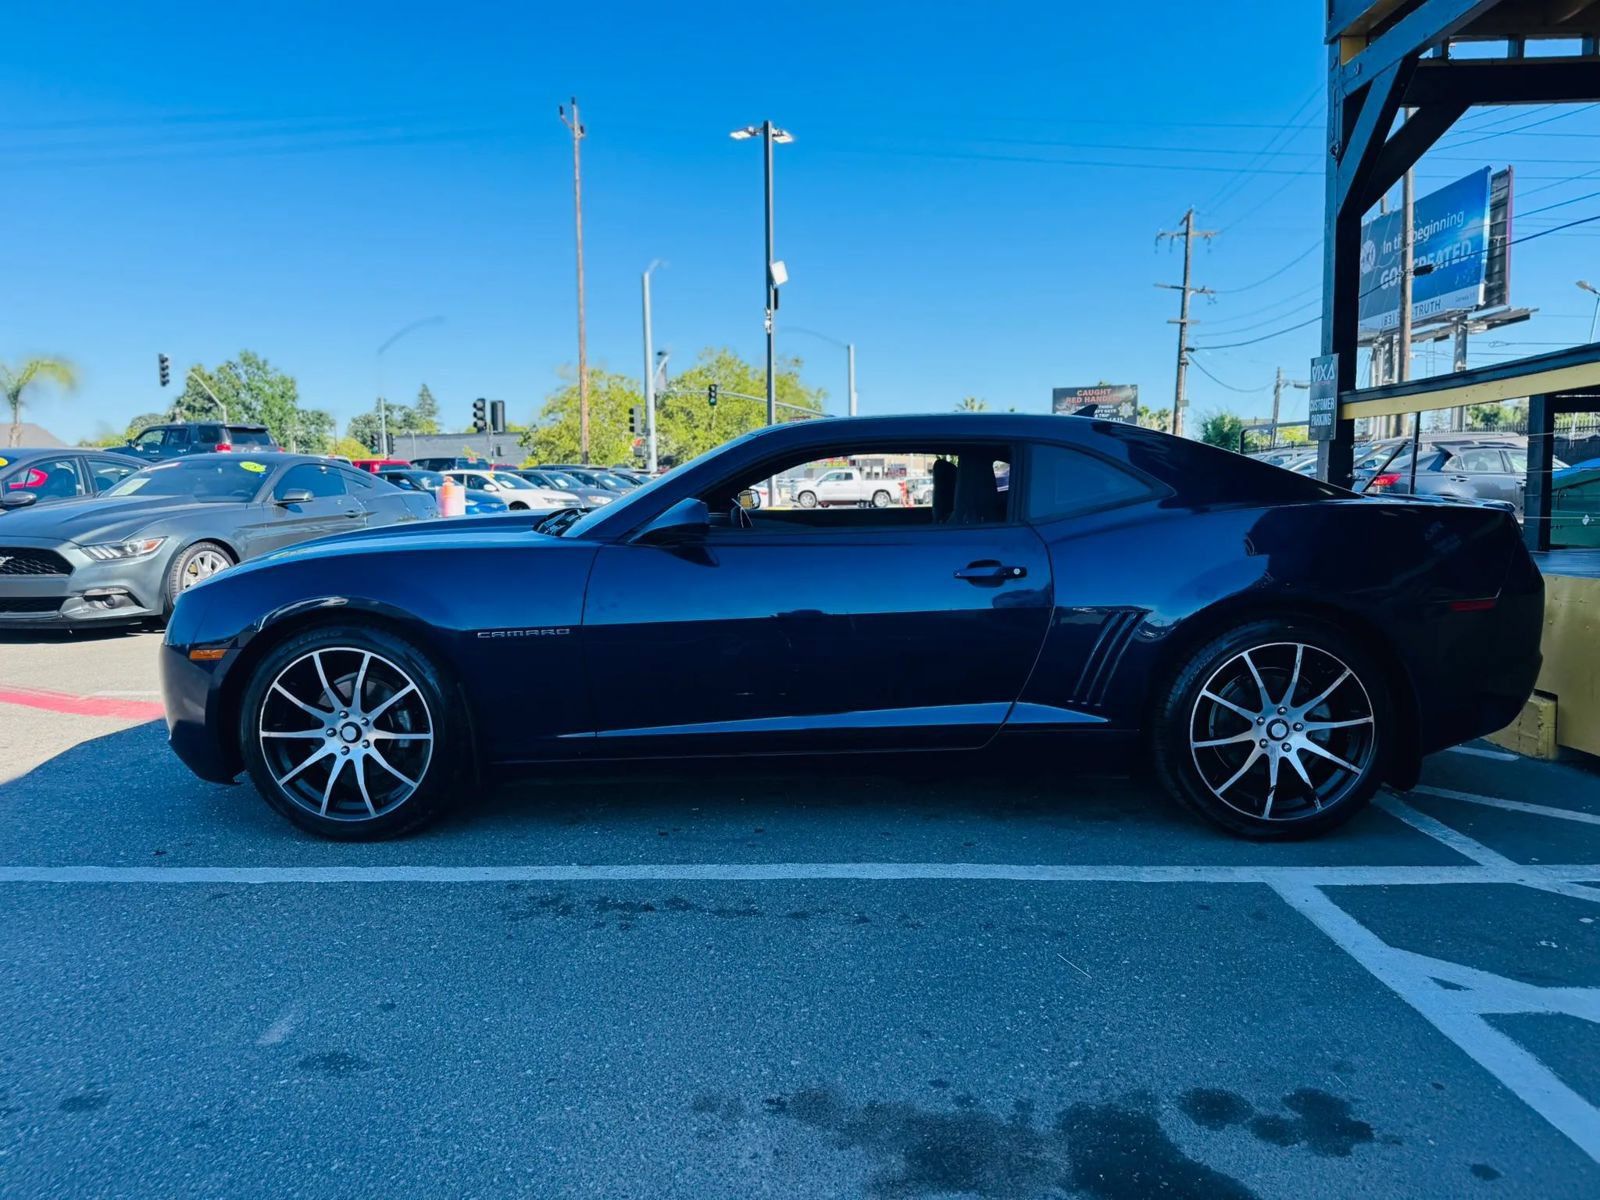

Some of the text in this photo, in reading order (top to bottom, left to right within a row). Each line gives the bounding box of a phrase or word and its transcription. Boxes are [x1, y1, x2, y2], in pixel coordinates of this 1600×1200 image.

[1383, 240, 1392, 255] In
[1077, 388, 1112, 397] CAUGHT
[1066, 396, 1082, 405] RED
[1309, 397, 1335, 411] CUSTOMER
[1311, 413, 1332, 427] PARKING
[477, 628, 570, 639] CAMARO
